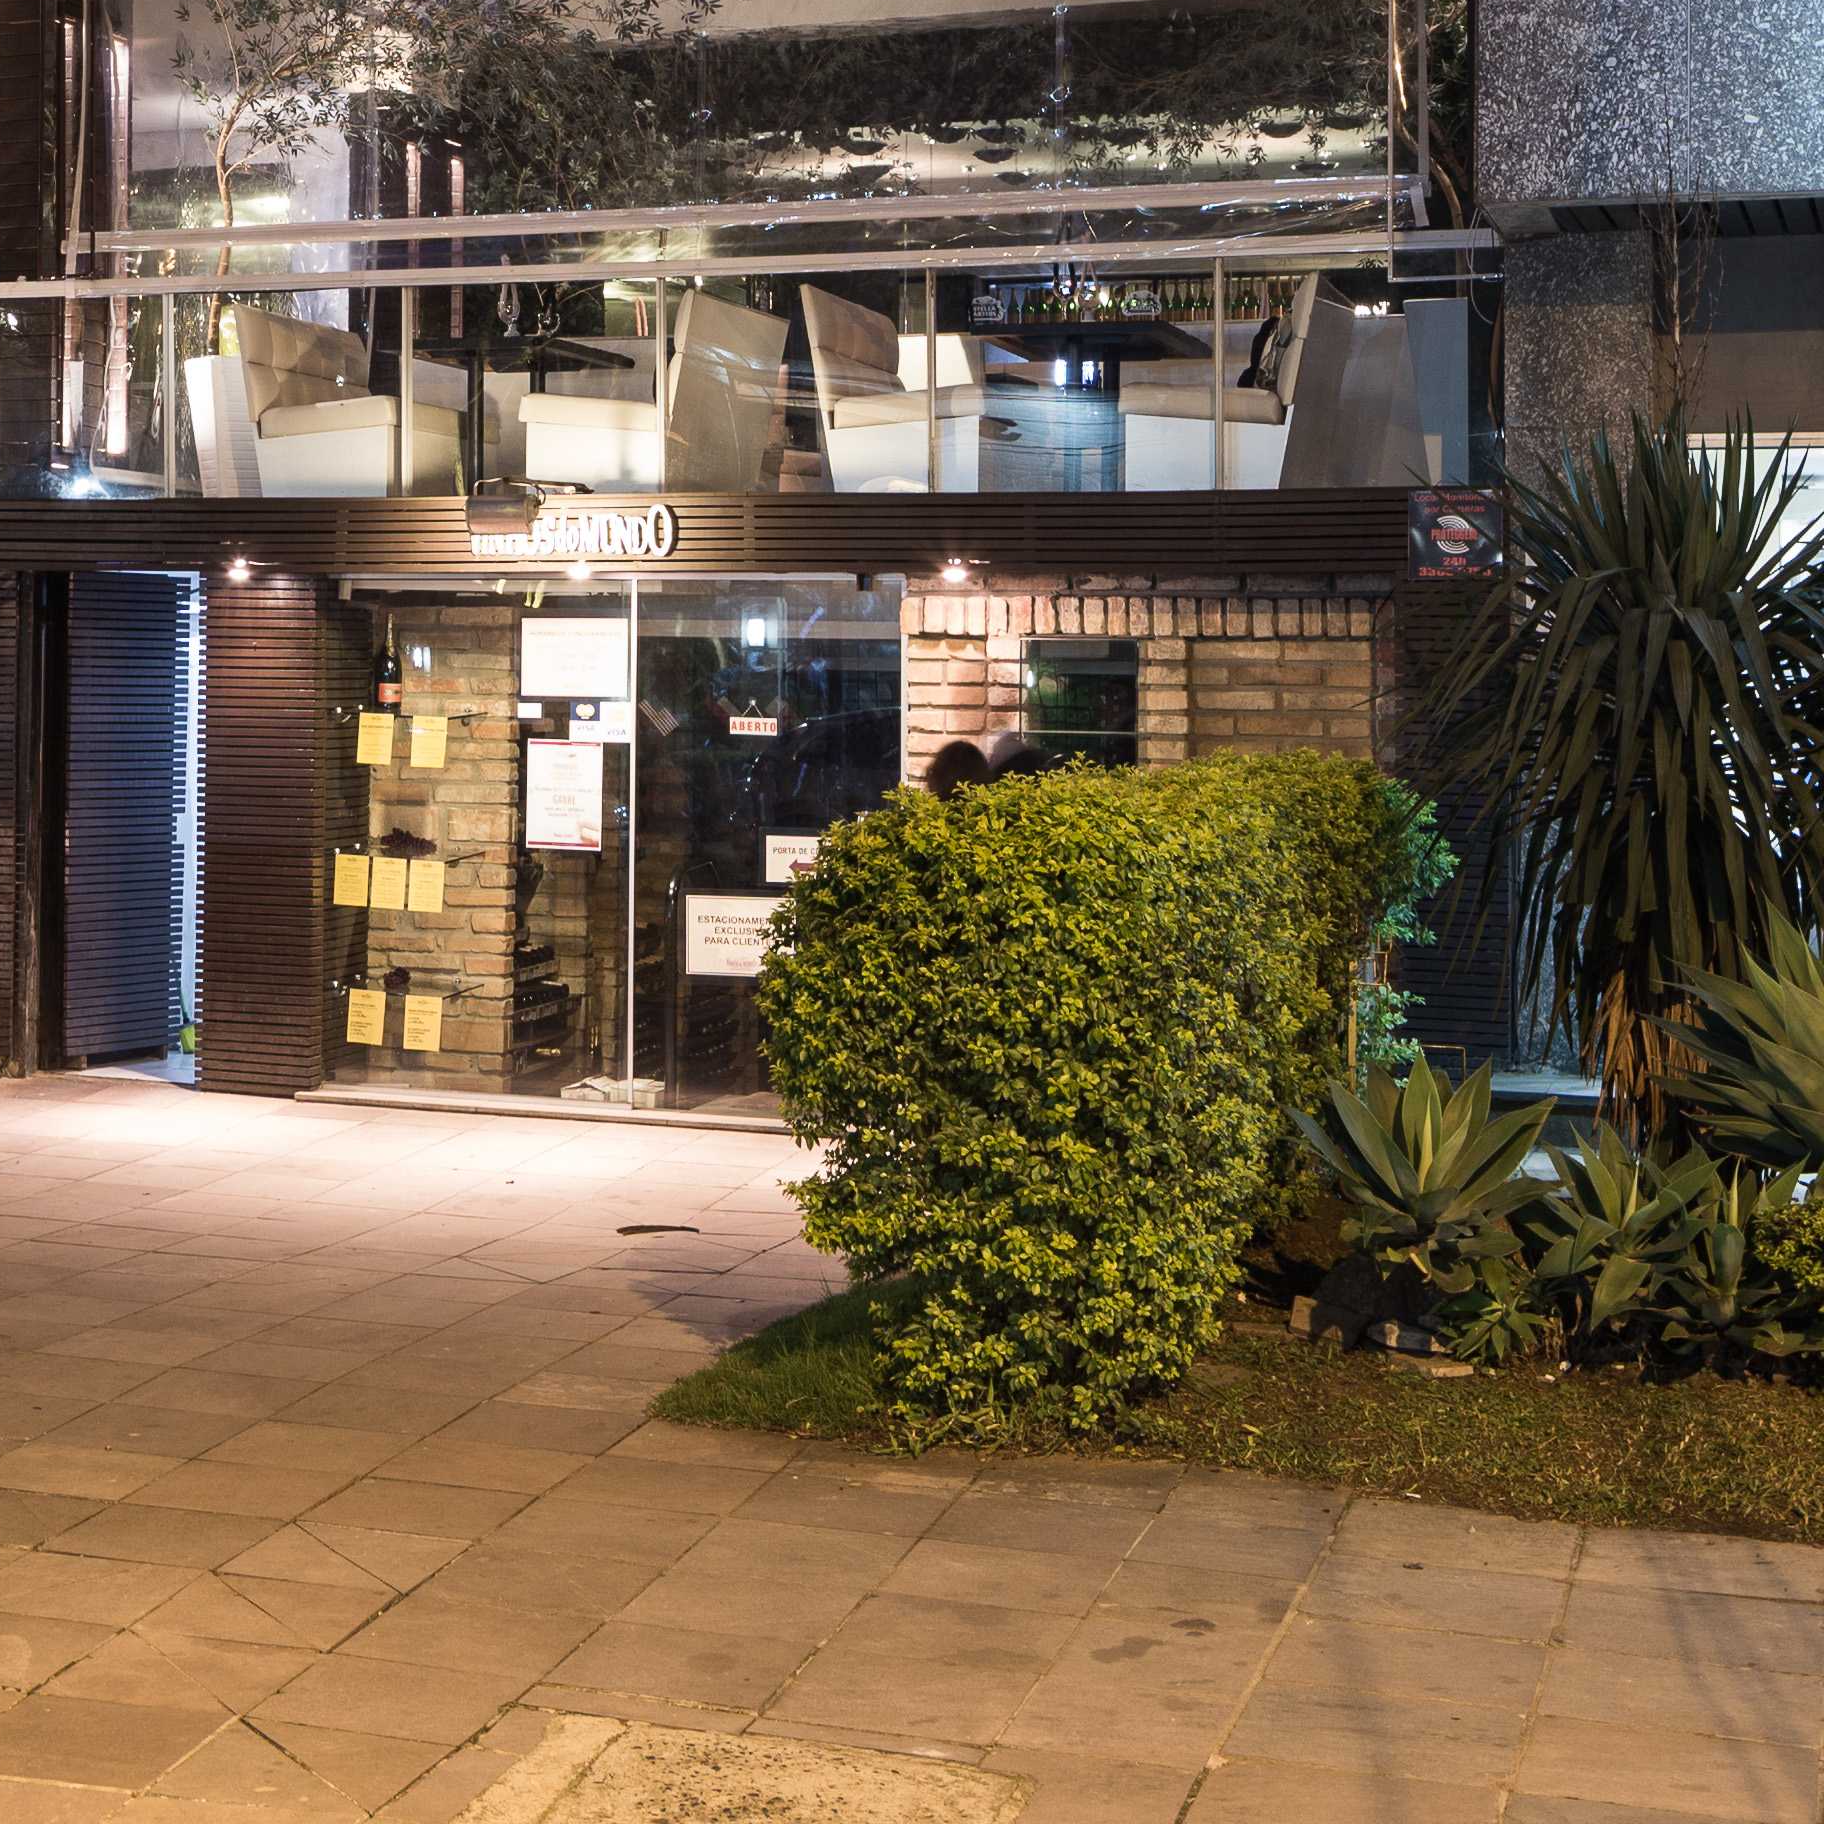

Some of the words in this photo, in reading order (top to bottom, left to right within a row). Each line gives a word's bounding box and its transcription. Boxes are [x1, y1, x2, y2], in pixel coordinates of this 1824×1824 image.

[731, 720, 776, 733] ABERTO
[772, 847, 796, 855] PORTA
[799, 847, 808, 855] DE
[697, 915, 772, 925] ESTACIONAMEN
[714, 927, 757, 936] EXCLUSI
[704, 937, 729, 945] PARA
